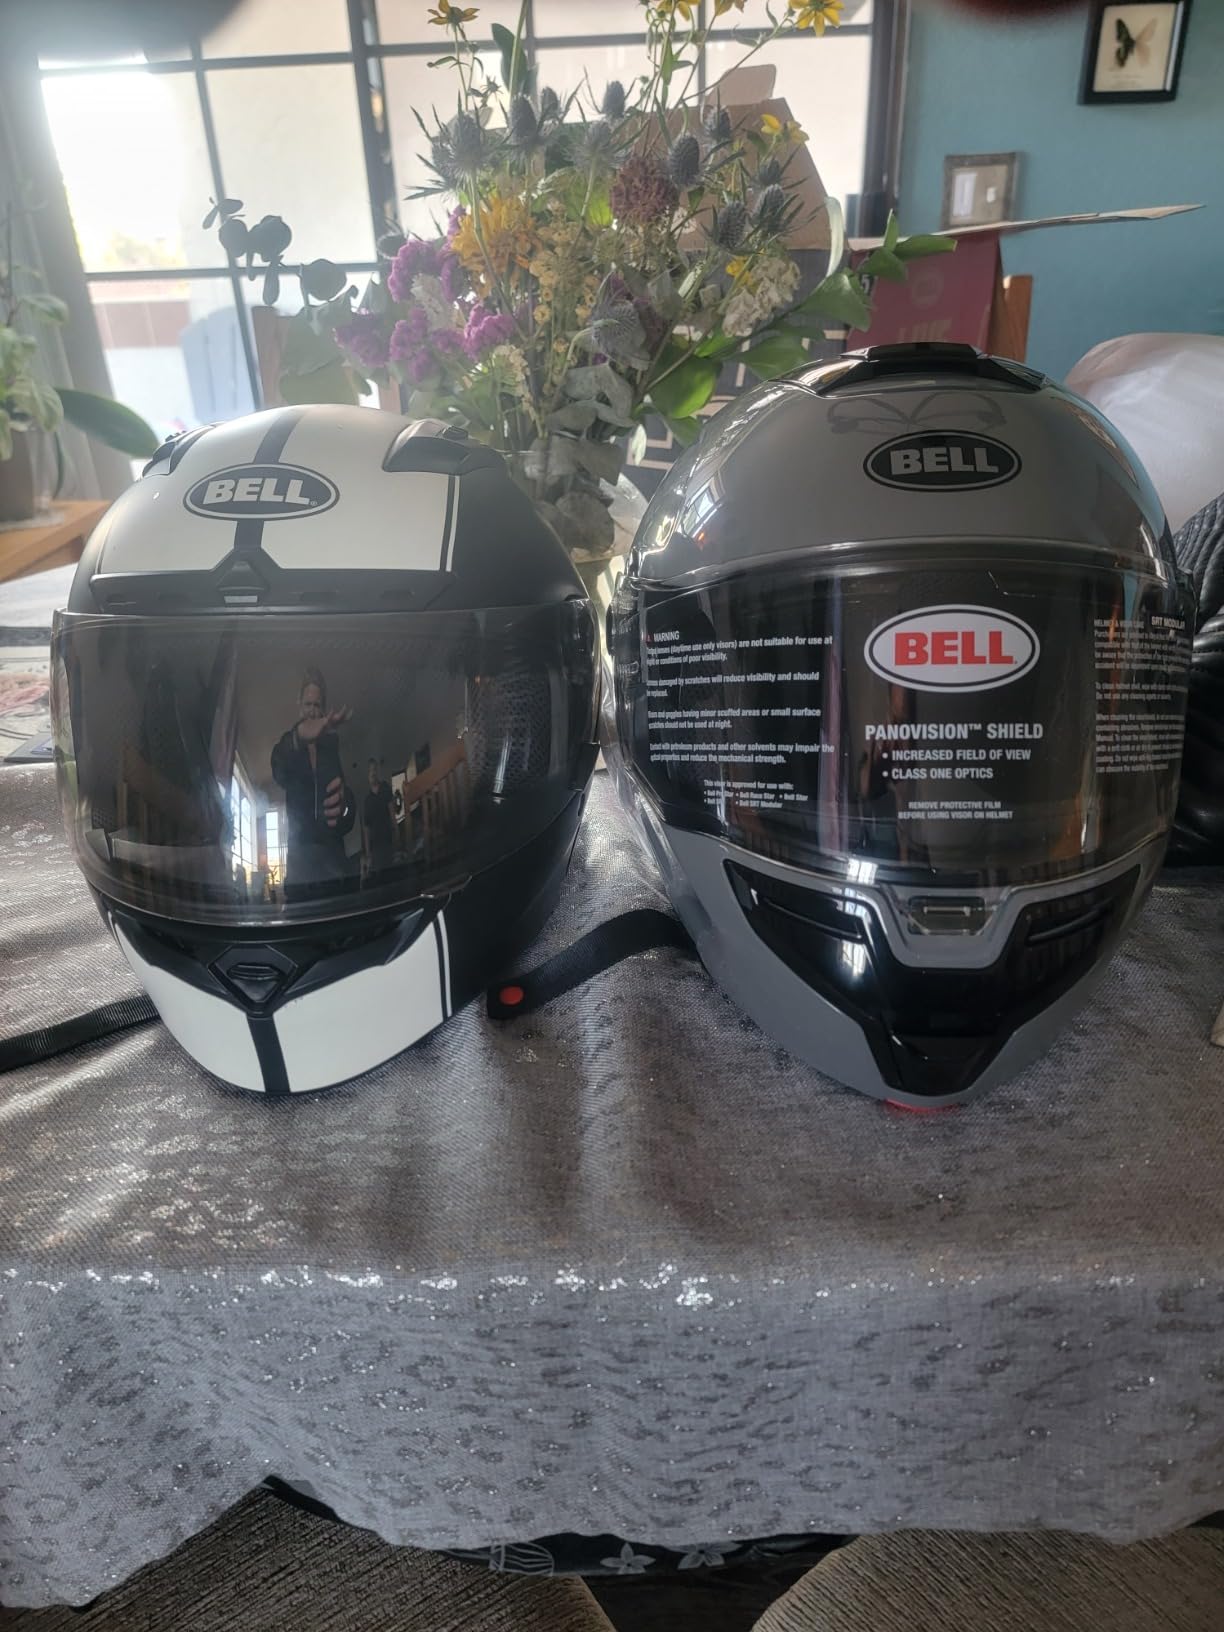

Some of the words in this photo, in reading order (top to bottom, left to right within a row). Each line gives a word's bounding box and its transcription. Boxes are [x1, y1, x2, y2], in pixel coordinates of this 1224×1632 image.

[890, 446, 999, 475] BELL
[202, 477, 311, 505] BELL
[653, 630, 680, 642] WARNING
[702, 641, 715, 651] only
[716, 639, 738, 650] visors)
[738, 640, 750, 648] are
[750, 637, 763, 647] not
[763, 636, 794, 647] suitable
[794, 635, 807, 645] for
[807, 637, 823, 645] use
[824, 635, 833, 645] at
[895, 631, 1014, 666] BELL
[682, 655, 688, 663] of
[688, 655, 701, 664] poor
[711, 674, 723, 683] will
[723, 673, 745, 683] reduce
[746, 672, 776, 683] visibility
[777, 671, 792, 681] and
[792, 671, 820, 681] should
[717, 707, 740, 717] scuffed
[741, 708, 760, 717] areas
[761, 708, 769, 717] or
[770, 707, 791, 717] small
[792, 707, 822, 717] surface
[678, 720, 687, 729] not
[708, 719, 714, 728] at
[986, 722, 1044, 740] SHIELD
[693, 742, 717, 752] products
[717, 742, 729, 751] and
[729, 742, 746, 751] other
[747, 742, 776, 751] solvents
[777, 744, 794, 754] may
[795, 743, 820, 754] impair
[821, 743, 835, 753] the
[718, 753, 754, 763] mechanical
[891, 749, 954, 761] INCREASED
[956, 749, 986, 761] FIELD
[988, 748, 1003, 761] OF
[1004, 748, 1032, 761] VIEW
[891, 767, 928, 780] CLASS
[929, 767, 953, 780] ONE
[954, 767, 994, 780] OPTICS
[908, 801, 939, 809] REMOVE
[939, 801, 983, 809] PROTECTIVE
[983, 801, 1001, 809] FILM
[897, 811, 926, 819] BEFORE
[927, 811, 950, 819] USING
[950, 811, 973, 819] VISOR
[973, 811, 985, 819] ON
[985, 811, 1013, 819] HELMET
